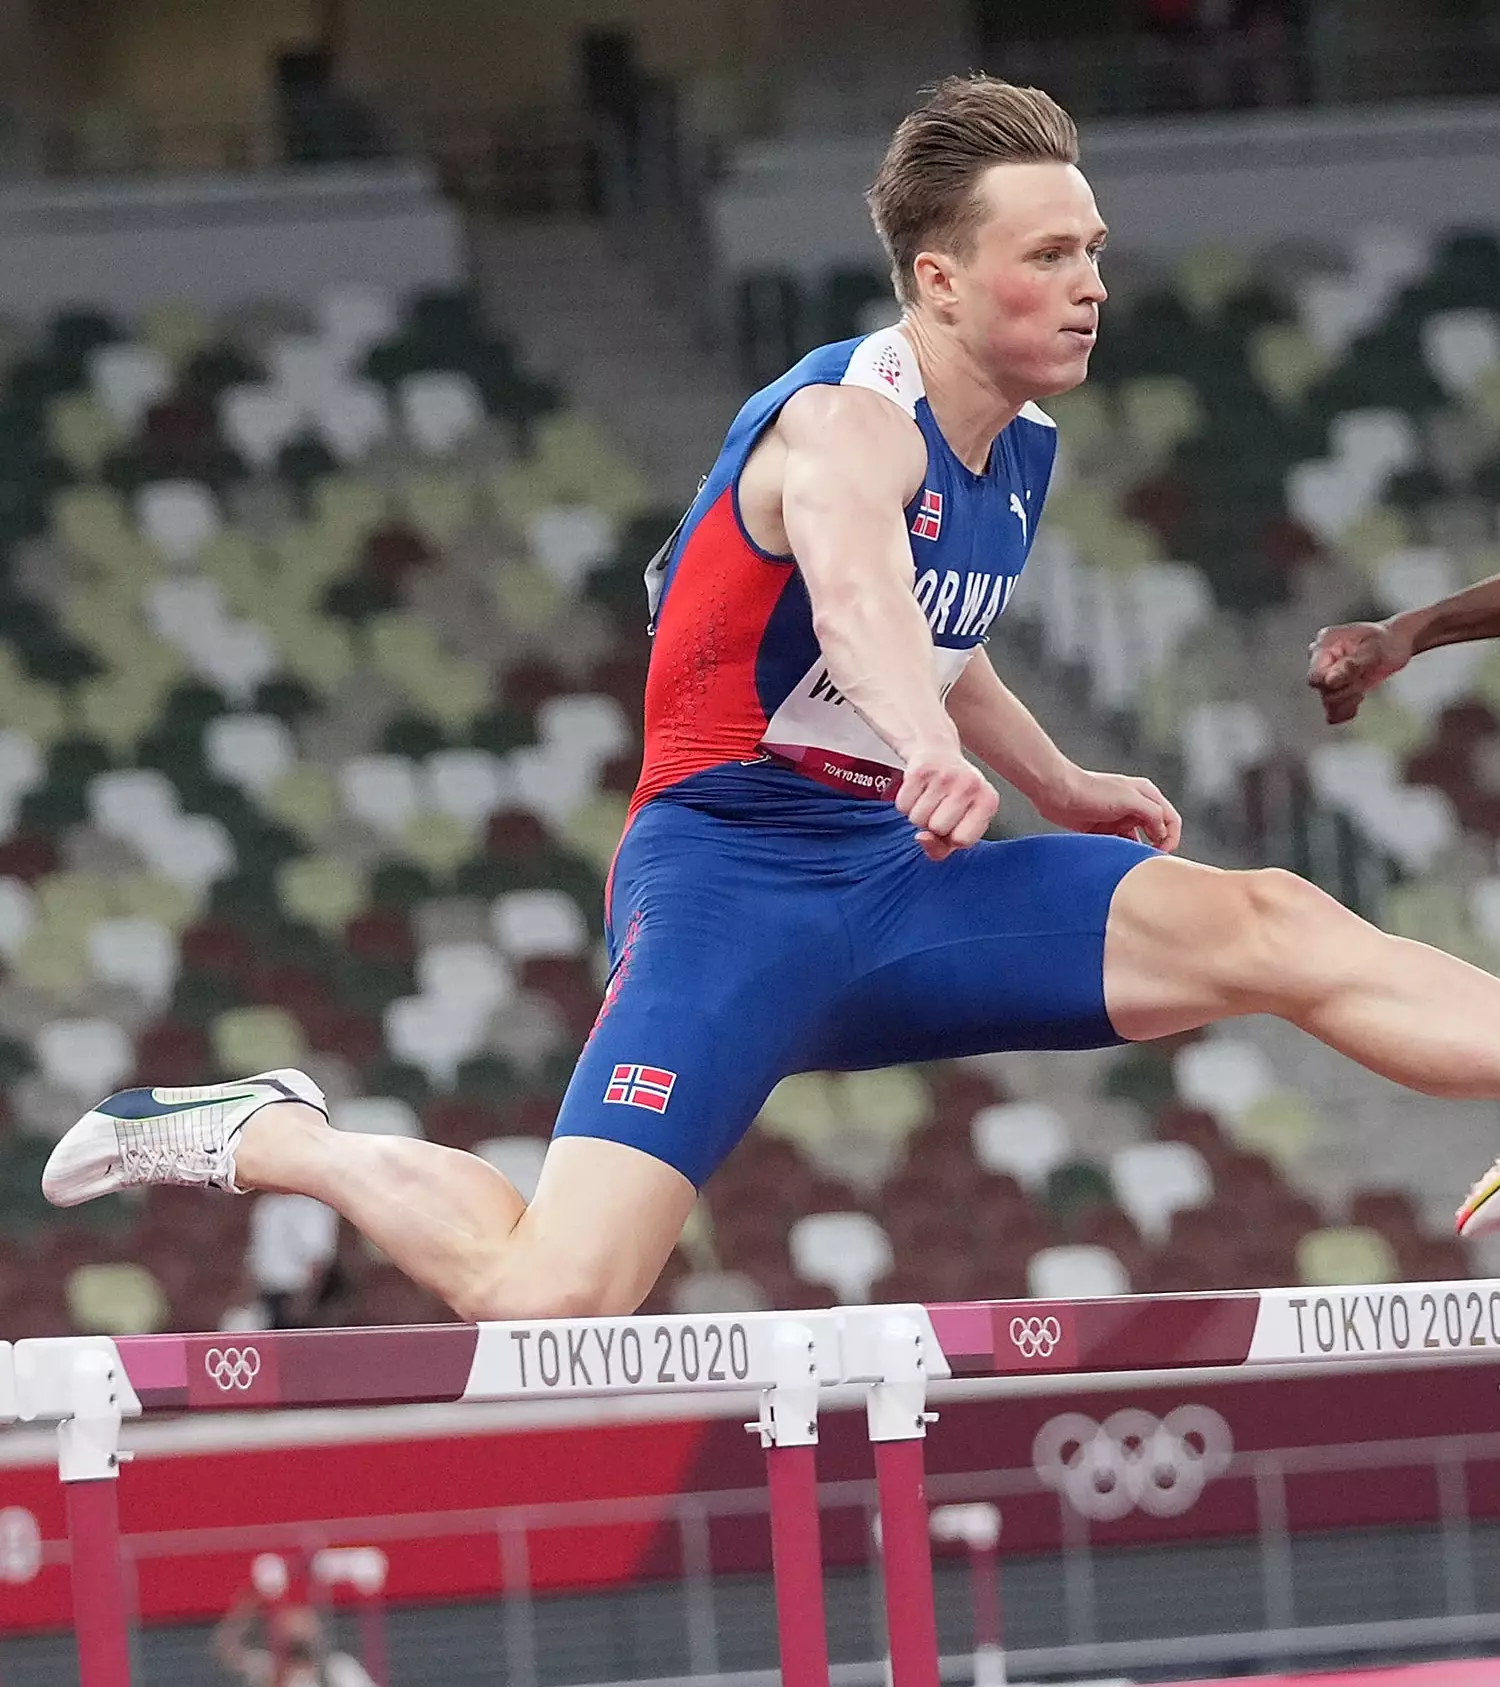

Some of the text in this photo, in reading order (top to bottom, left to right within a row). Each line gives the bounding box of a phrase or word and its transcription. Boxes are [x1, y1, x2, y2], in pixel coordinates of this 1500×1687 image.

[912, 568, 1020, 636] ORWAY
[822, 761, 874, 788] TOKYO 2020
[511, 1323, 749, 1387] TOKYO 2020
[1289, 1294, 1410, 1354] TOKYO
